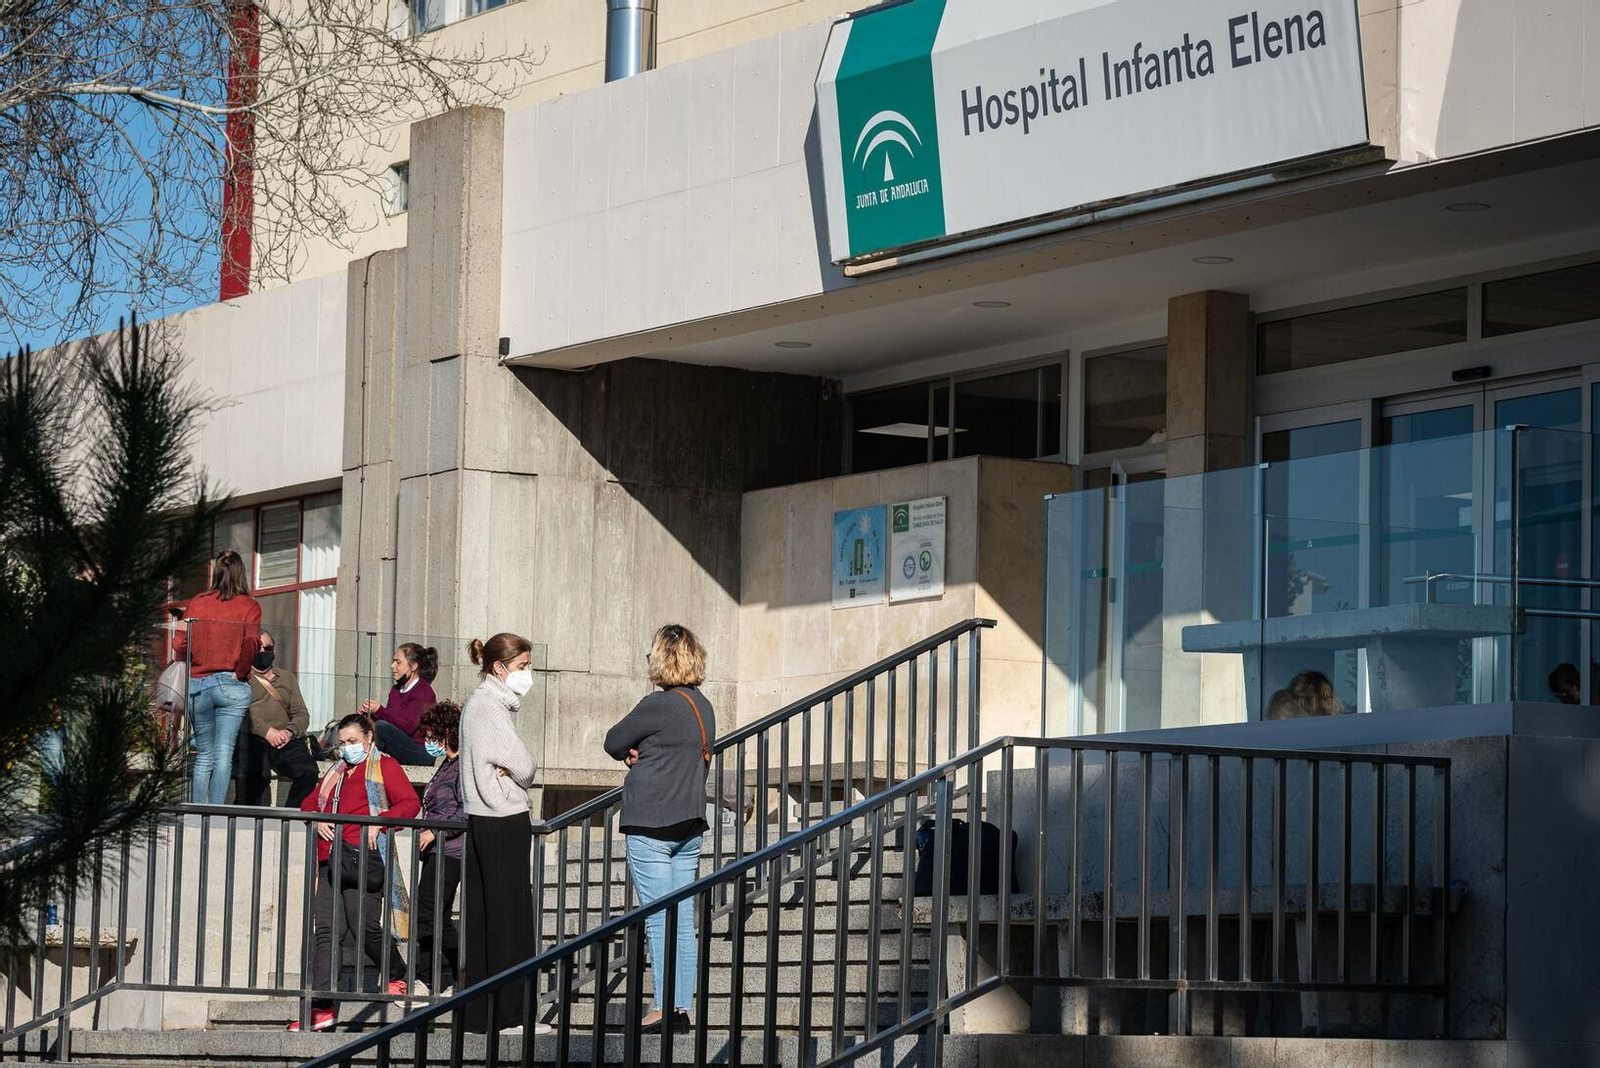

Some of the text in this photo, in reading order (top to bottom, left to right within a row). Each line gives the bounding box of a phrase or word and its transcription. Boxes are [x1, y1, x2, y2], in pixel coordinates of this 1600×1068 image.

[961, 9, 1327, 136] Hospital Infanta Elena
[856, 191, 878, 209] JUNTA
[879, 188, 889, 204] DE
